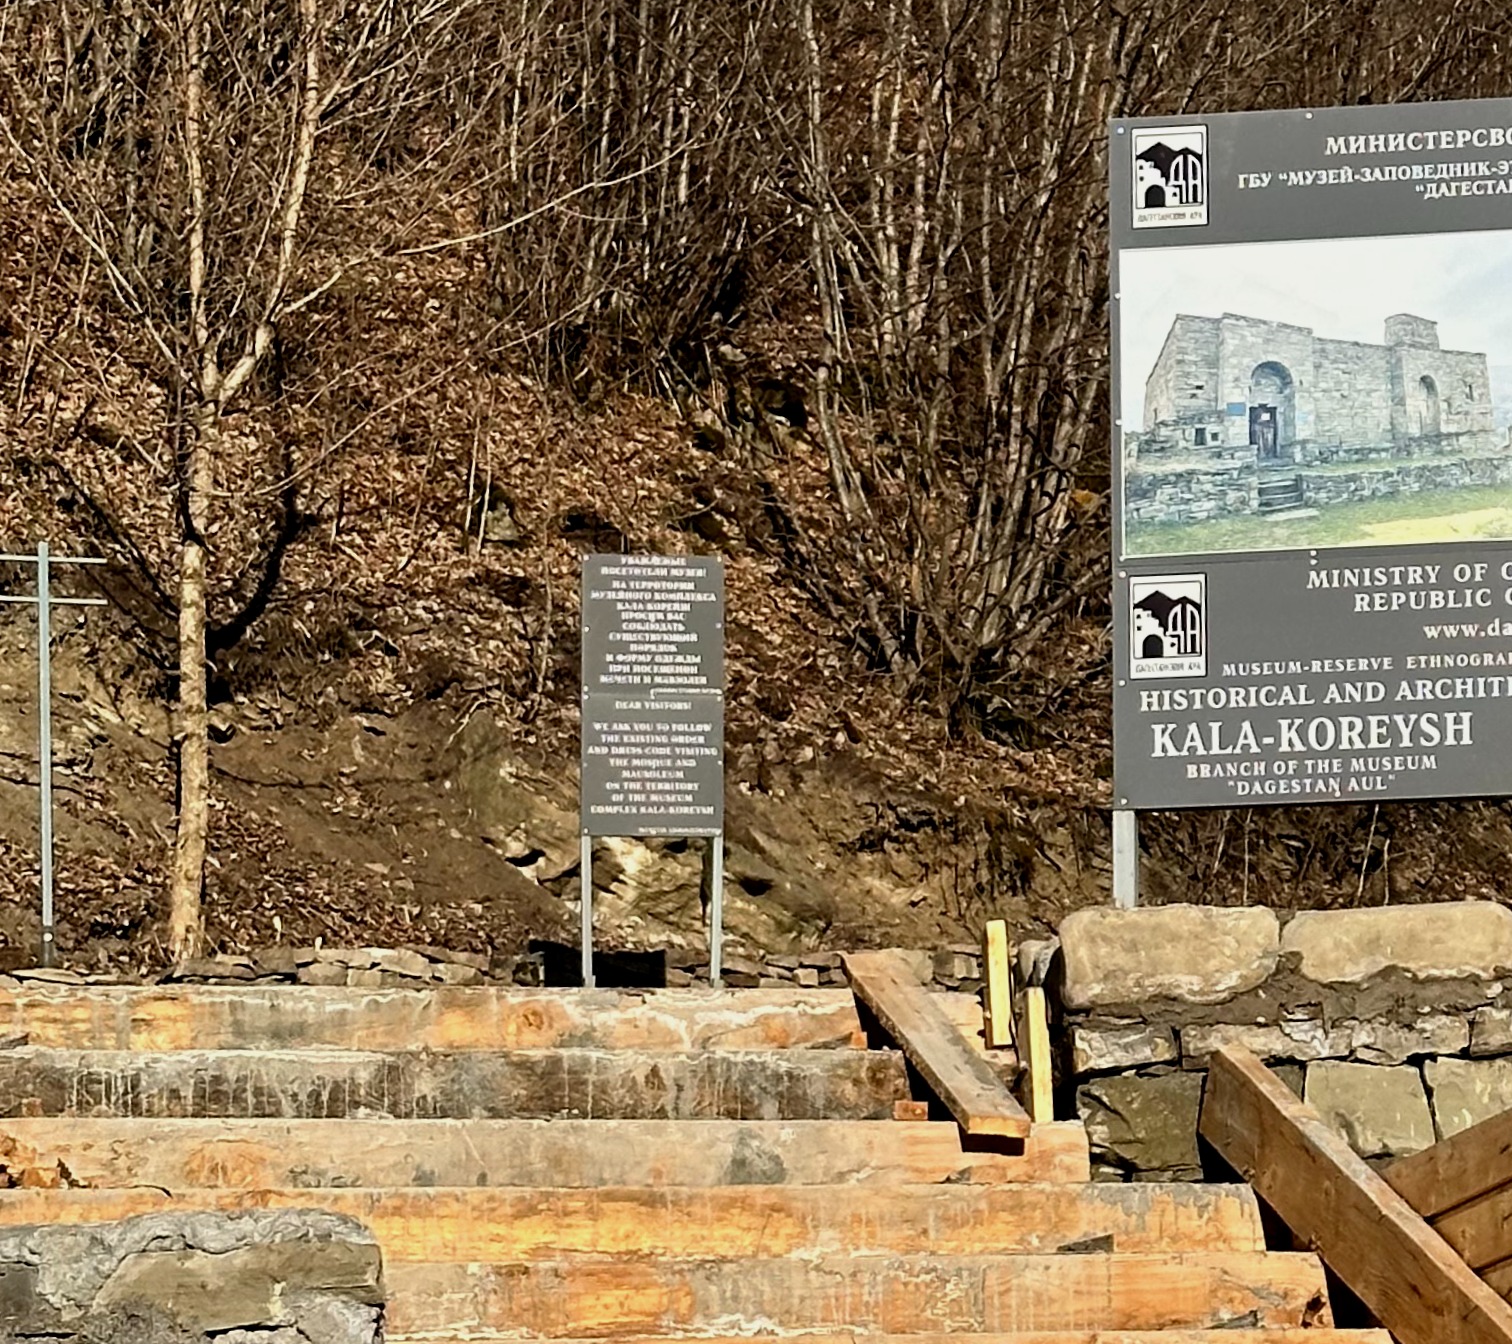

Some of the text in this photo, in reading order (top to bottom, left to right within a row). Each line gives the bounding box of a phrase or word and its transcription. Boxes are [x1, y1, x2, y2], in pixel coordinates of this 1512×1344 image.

[1238, 172, 1272, 189] ГБУ
[1306, 565, 1441, 589] MINISTRY
[1453, 563, 1488, 583] OF
[612, 580, 627, 589] НА
[1353, 588, 1492, 612] REPUBLIC
[666, 612, 686, 621] ВАС
[1222, 657, 1394, 677] MUSEUM-RESERVE
[1139, 684, 1316, 712] HISTORICAL
[1322, 681, 1386, 704] AND
[615, 700, 692, 710] DEAR VISITORS!
[592, 722, 713, 732] WE ASK YOU TO FOLLOW
[601, 734, 619, 743] THE
[623, 734, 668, 743] EXISTING
[1150, 711, 1473, 758] KALA-KOREYSH
[587, 745, 609, 755] AND
[674, 746, 718, 756] VISITING
[609, 758, 697, 769] THE MOSQUE AND
[1186, 754, 1437, 779] BRANCH OF THE MUSEUM
[623, 781, 643, 790] THE
[645, 782, 700, 791] TERRITORY
[611, 793, 694, 803] OF THE MUSEUM
[590, 805, 638, 814] COMPLEX
